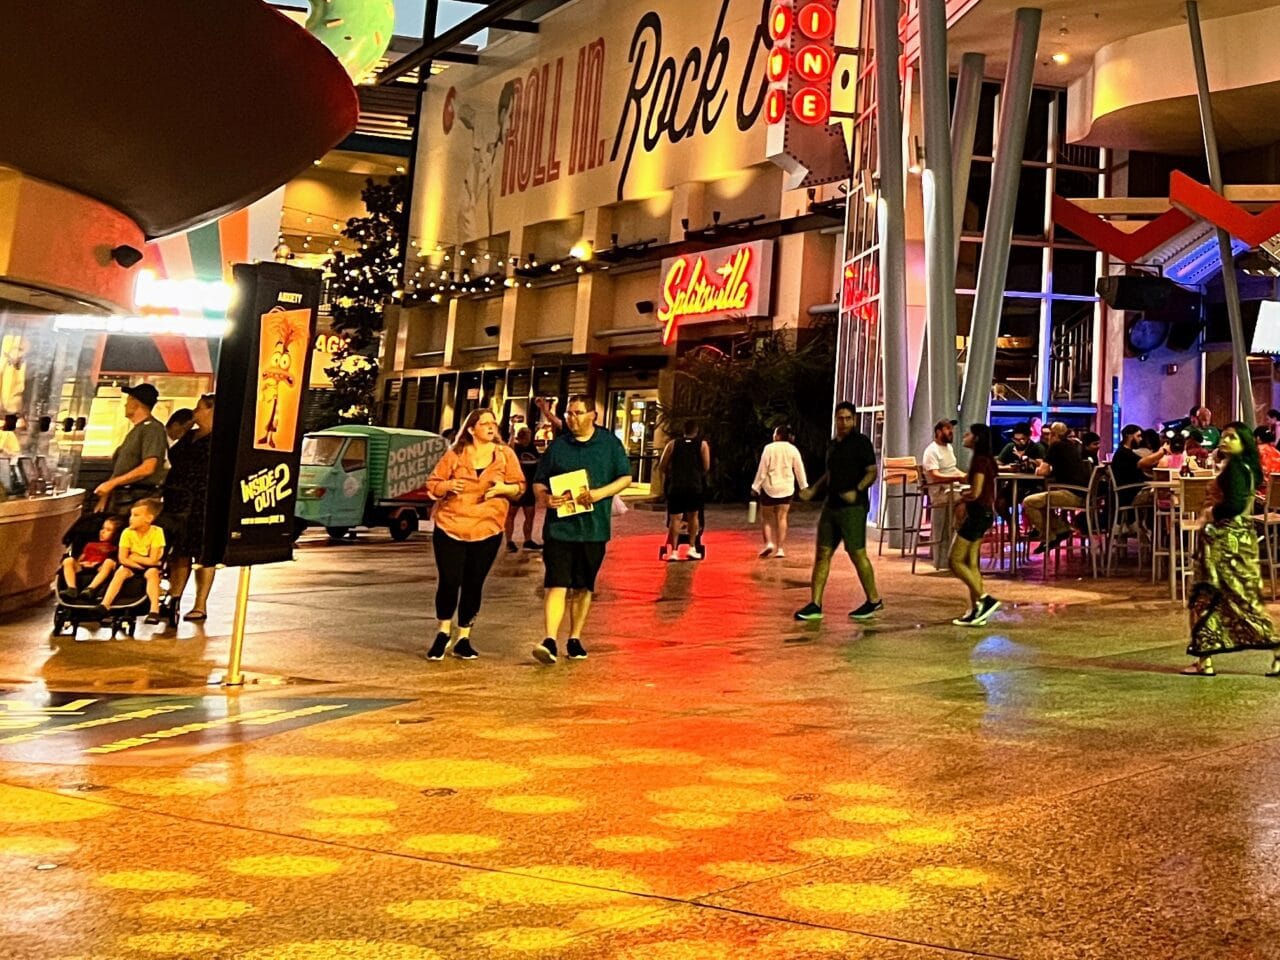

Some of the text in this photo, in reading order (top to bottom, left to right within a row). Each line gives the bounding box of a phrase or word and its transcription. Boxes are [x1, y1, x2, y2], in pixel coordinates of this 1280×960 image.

[500, 57, 564, 197] ROLL
[657, 247, 749, 347] Splitsville
[240, 470, 277, 503] INSIDE
[254, 463, 292, 512] OUT 2
[387, 456, 426, 482] MAKE
